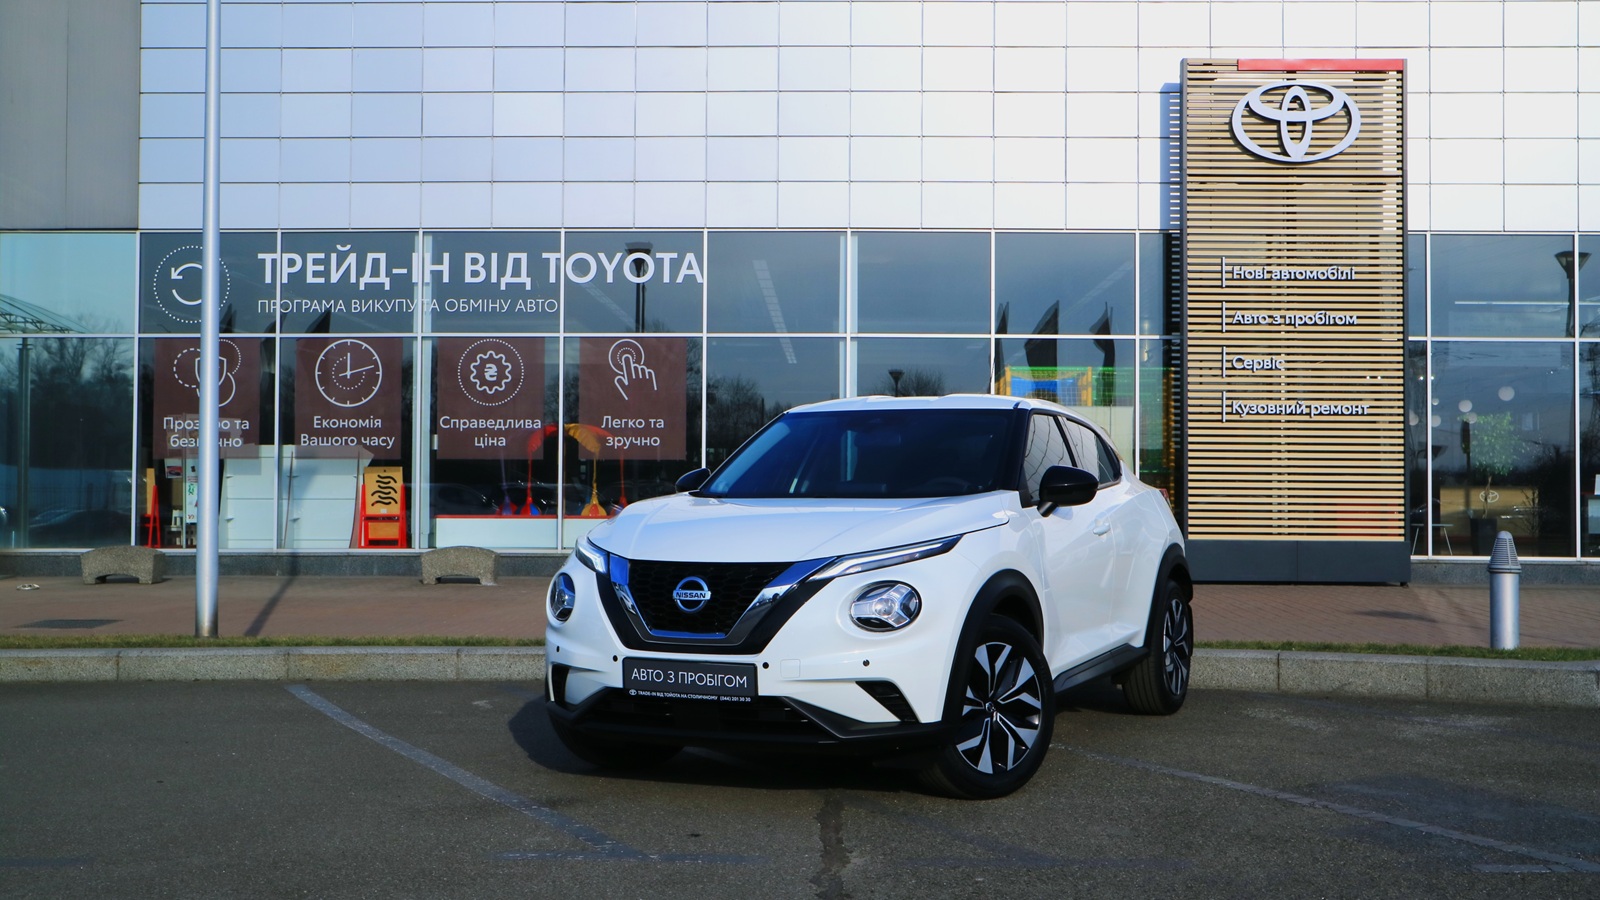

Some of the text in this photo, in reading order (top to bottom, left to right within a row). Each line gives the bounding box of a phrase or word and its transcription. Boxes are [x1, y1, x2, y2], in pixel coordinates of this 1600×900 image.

[257, 244, 704, 290] ТРЕЙД-ІН ВІД TOYOTA
[1232, 265, 1355, 280] Нові автомобілі
[258, 298, 558, 313] ПРОГРАМА ВИКУПУ ТА ОБМІНУ АВТО
[1232, 311, 1357, 328] Авто з пробігом
[1232, 355, 1285, 372] Сервіс
[1232, 400, 1369, 418] Кузовний ремонт
[163, 417, 250, 433] Прозо та
[313, 415, 382, 429] Економія
[439, 415, 542, 432] Справедлива
[600, 416, 665, 429] Легко та
[300, 434, 395, 450] Вашого часу
[474, 434, 507, 448] ціна
[605, 436, 661, 450] зручно
[675, 591, 706, 599] NISSAN
[631, 668, 664, 682] АВТО
[678, 671, 748, 688] ПРОБІГОМ
